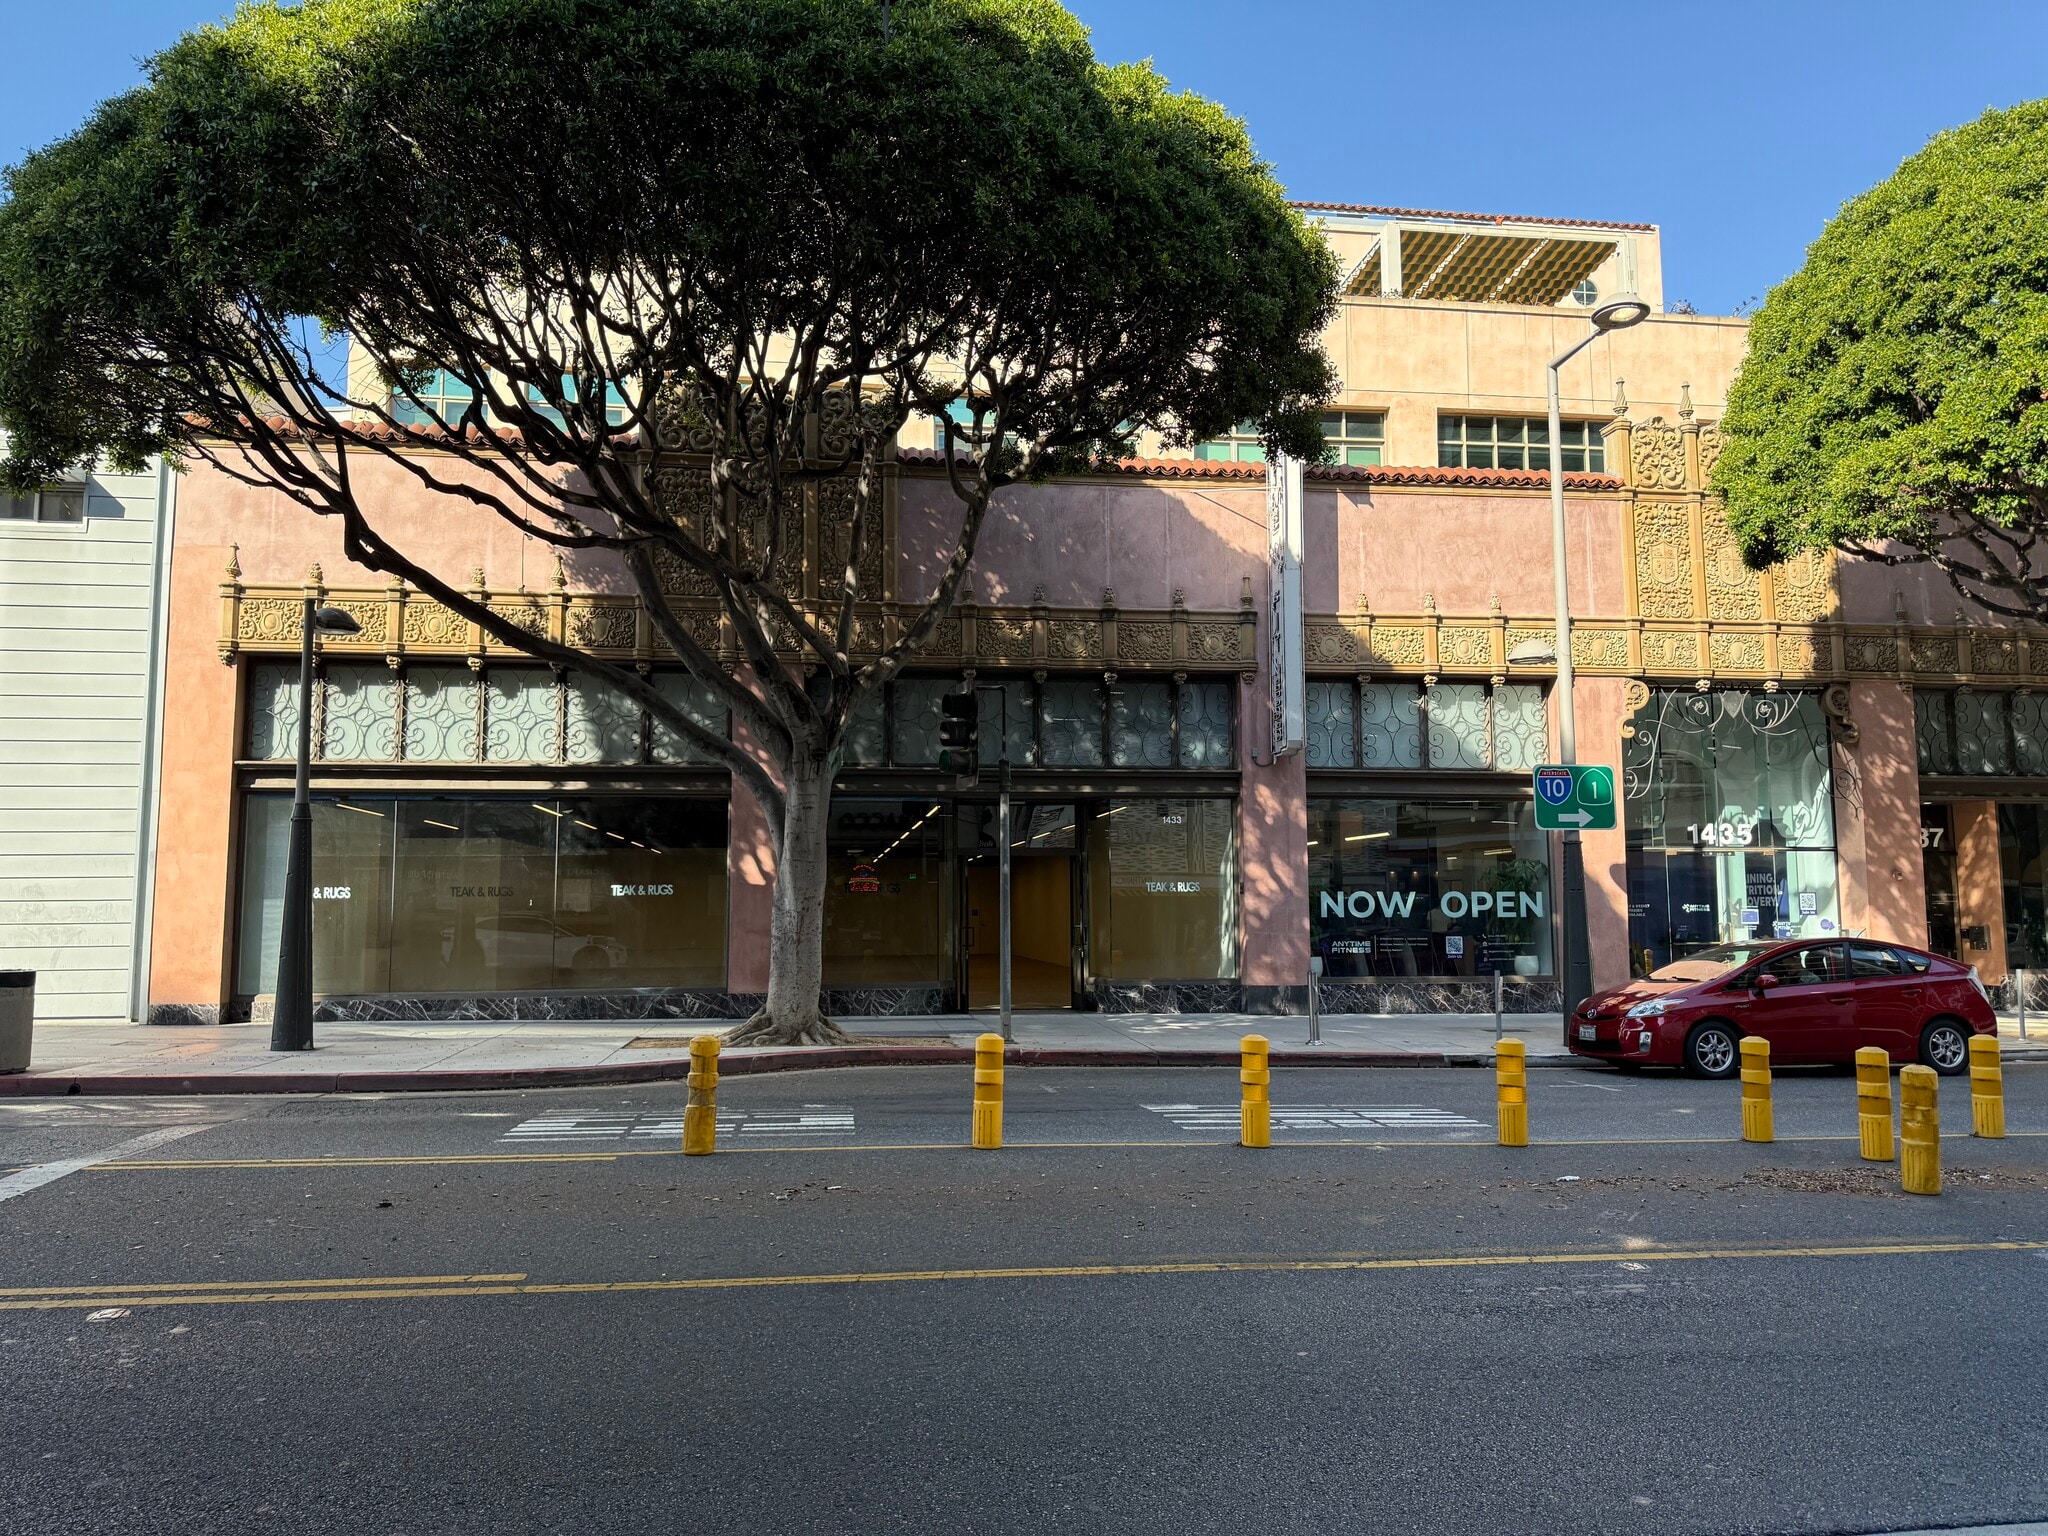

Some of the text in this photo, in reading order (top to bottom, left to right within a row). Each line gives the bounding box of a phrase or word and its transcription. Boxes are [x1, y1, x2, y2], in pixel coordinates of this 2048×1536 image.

[1545, 779, 1565, 797] 10
[1591, 781, 1597, 799] 1
[1162, 816, 1182, 824] 1433
[1687, 823, 1752, 845] 1435
[313, 887, 351, 898] & RUGS
[450, 886, 514, 897] TEAK & RUGS
[610, 884, 674, 896] TEAK & RUGS
[1146, 882, 1200, 892] TEAK & RUGS
[1320, 891, 1543, 918] NOW OPEN
